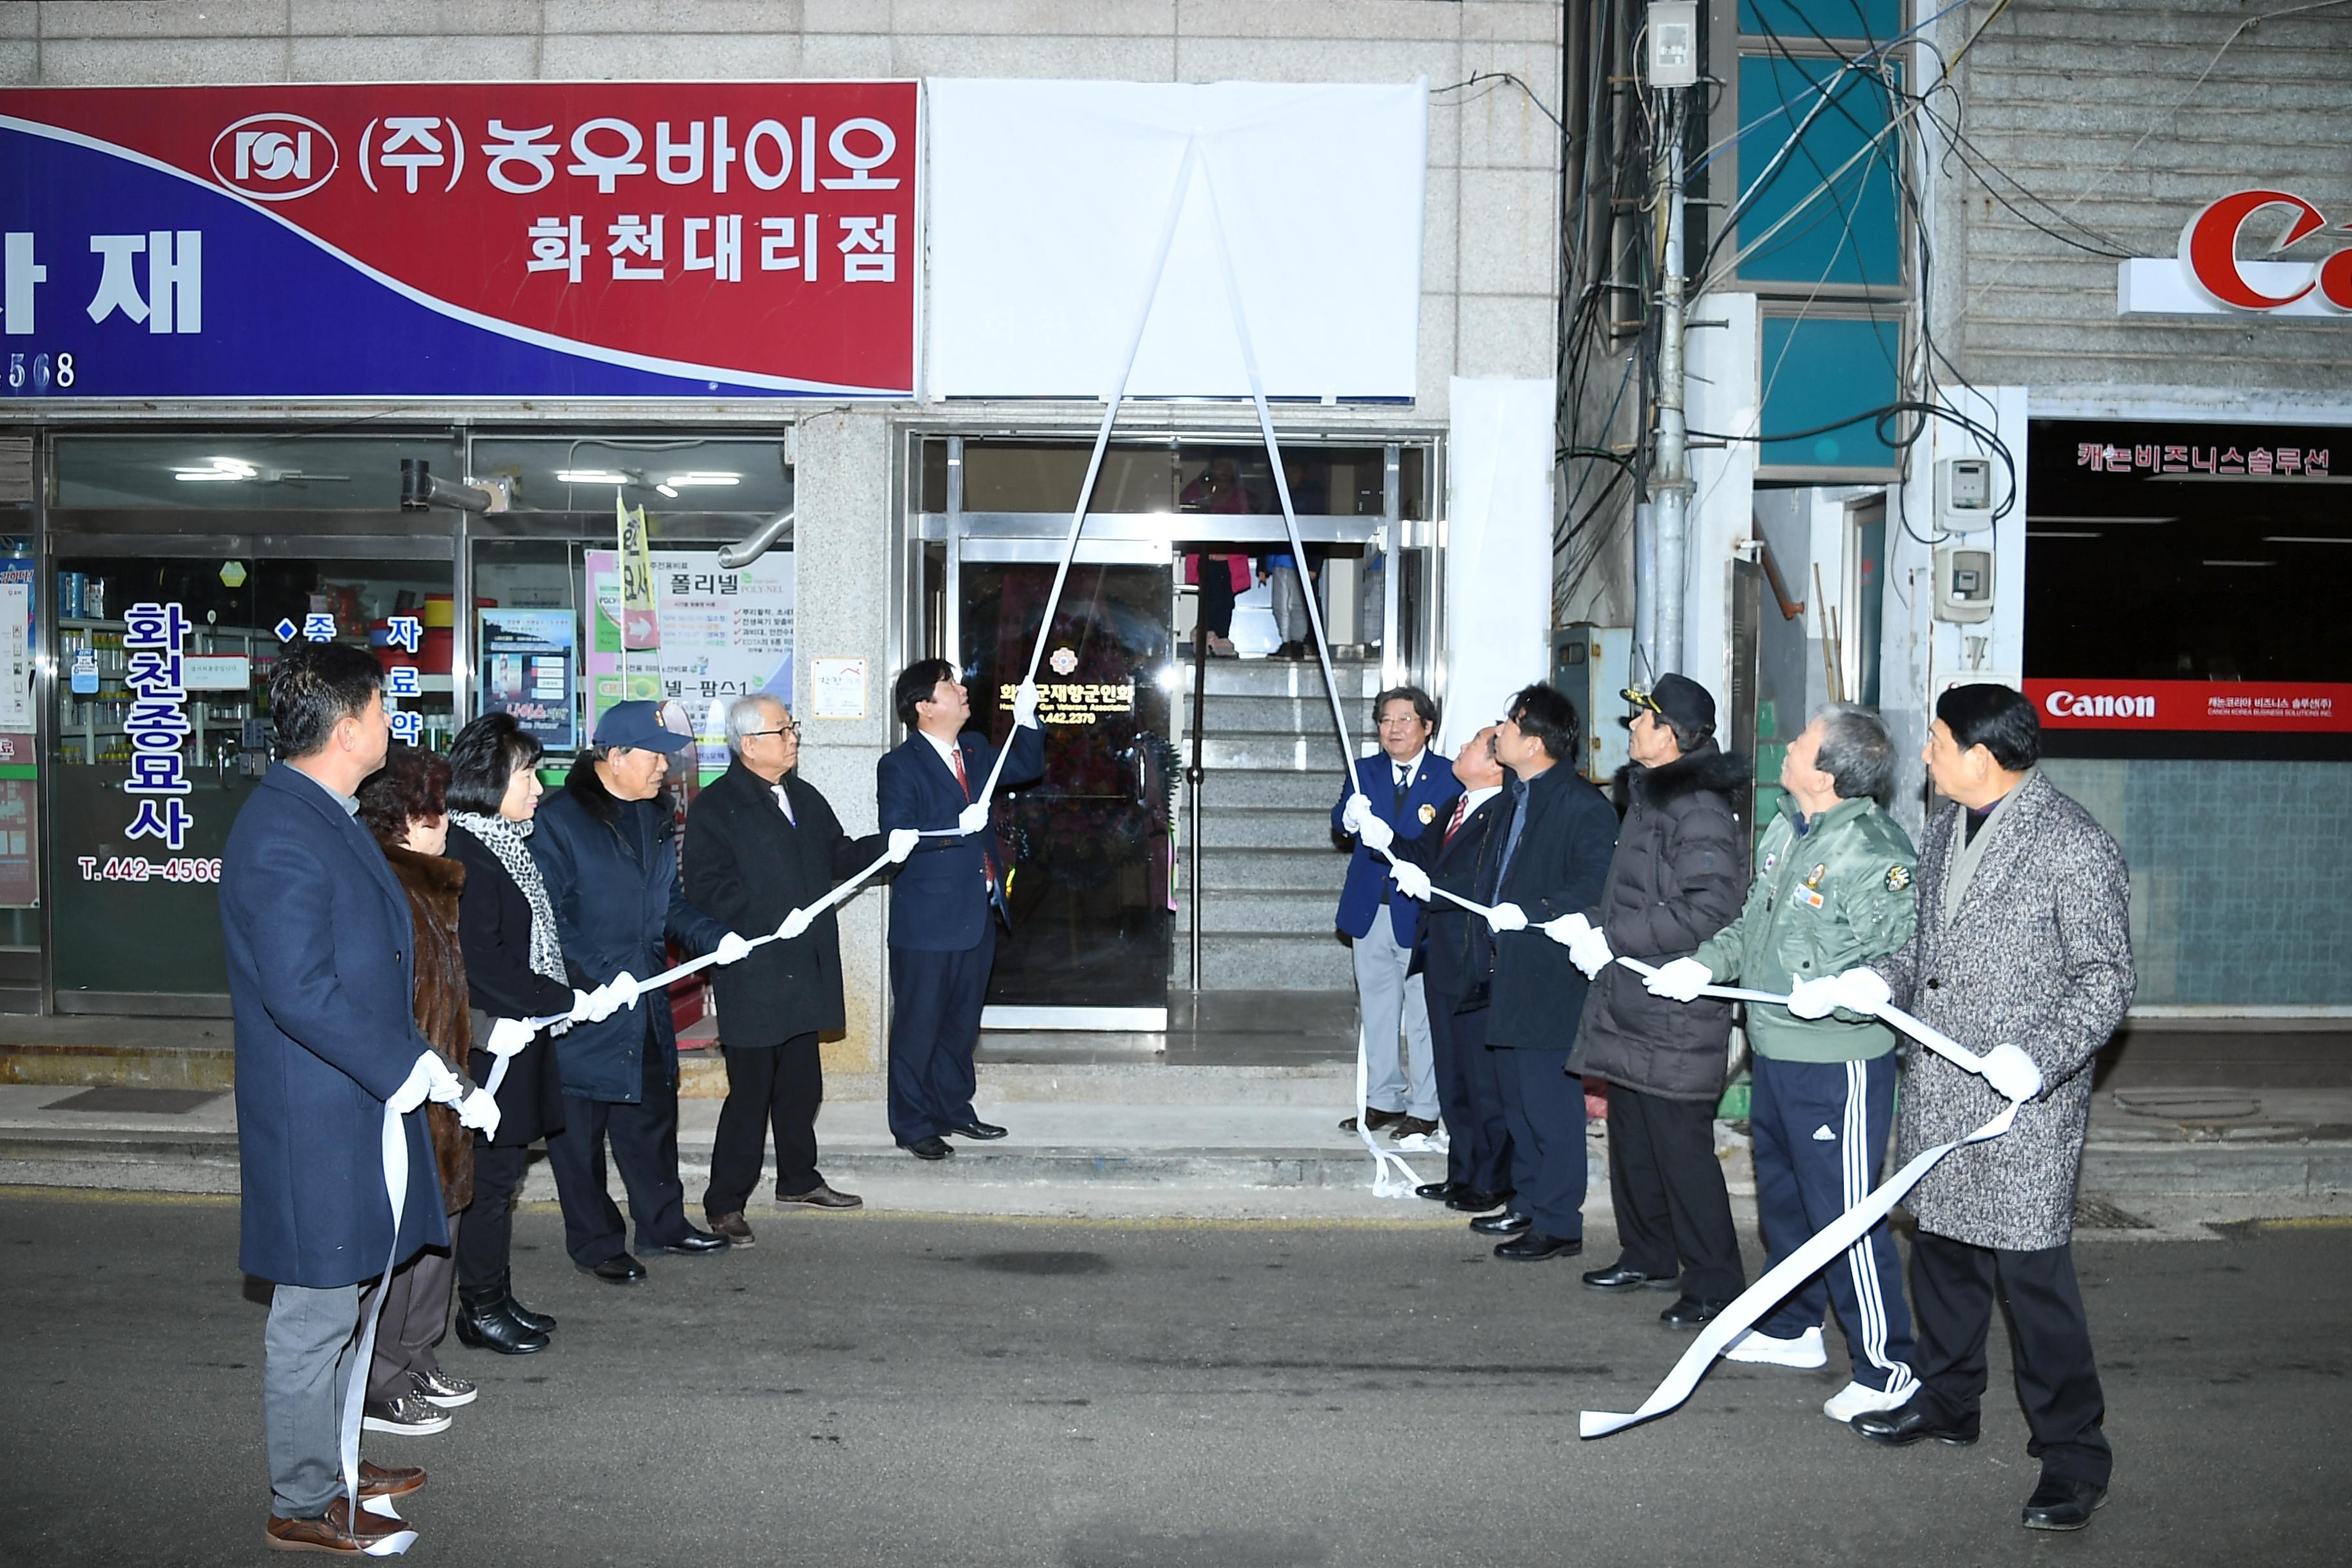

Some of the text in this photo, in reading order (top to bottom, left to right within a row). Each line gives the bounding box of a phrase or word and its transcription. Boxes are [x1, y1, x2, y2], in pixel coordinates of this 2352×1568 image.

[525, 213, 897, 282] 화천대리점
[2077, 442, 2330, 476] 캐논비즈니스솔루션
[671, 573, 738, 595] 폴리넬
[1000, 683, 1133, 704] 화군재향군인회
[2045, 691, 2156, 719] Canon
[2254, 697, 2289, 709] 비즈니스
[123, 602, 194, 850] 화천종묘사
